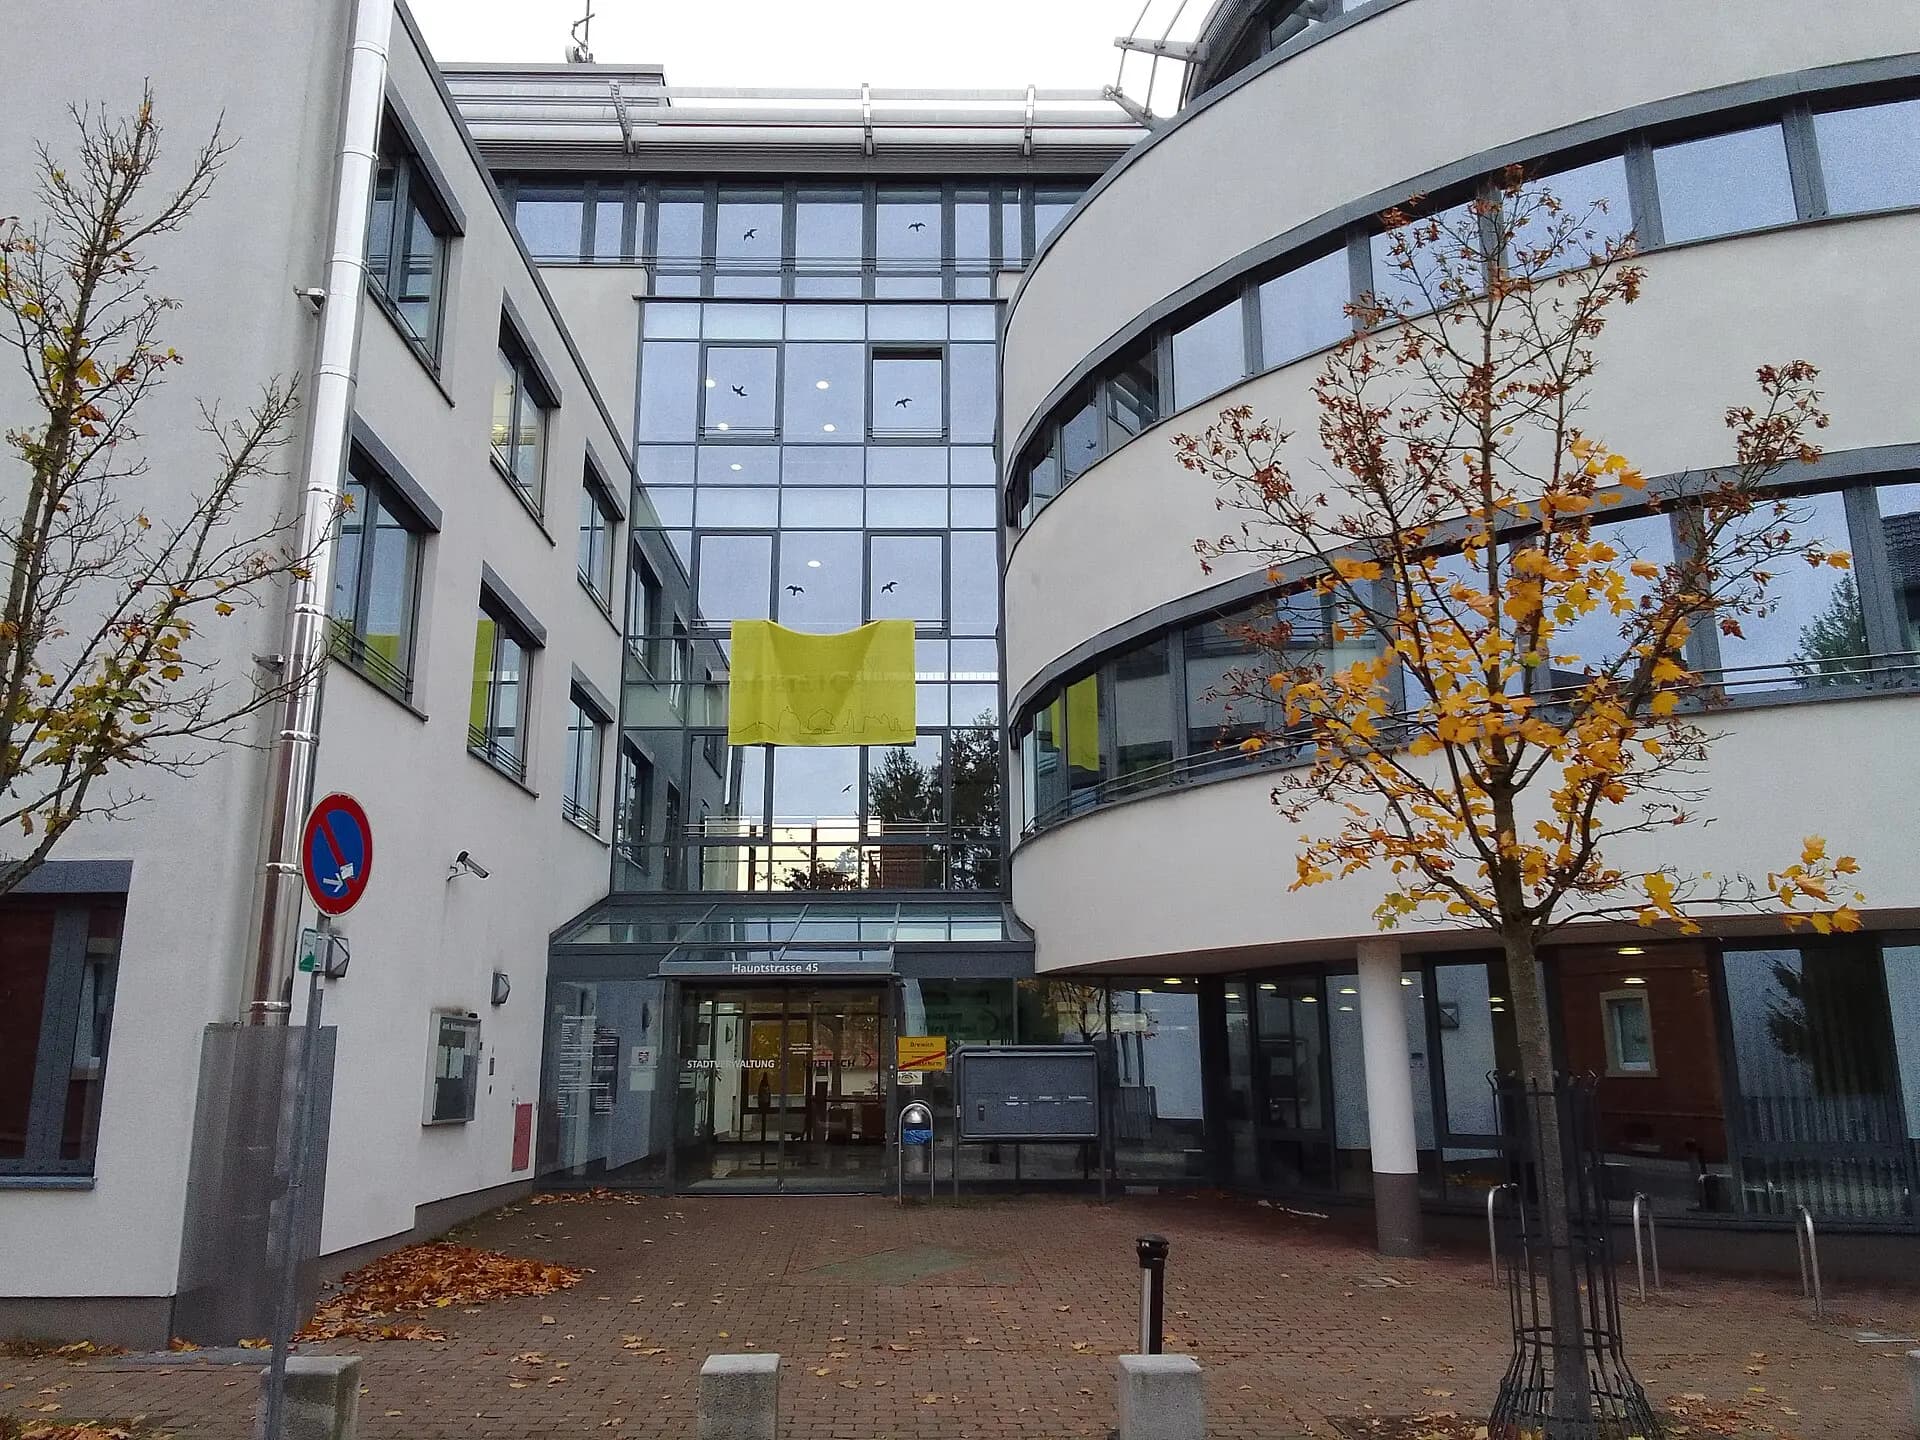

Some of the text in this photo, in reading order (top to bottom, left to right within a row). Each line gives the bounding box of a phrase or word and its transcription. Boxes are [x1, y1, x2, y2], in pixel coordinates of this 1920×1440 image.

[732, 963, 818, 974] Hauptstrasse 45
[687, 1060, 775, 1068] STADTVWALTUNG
